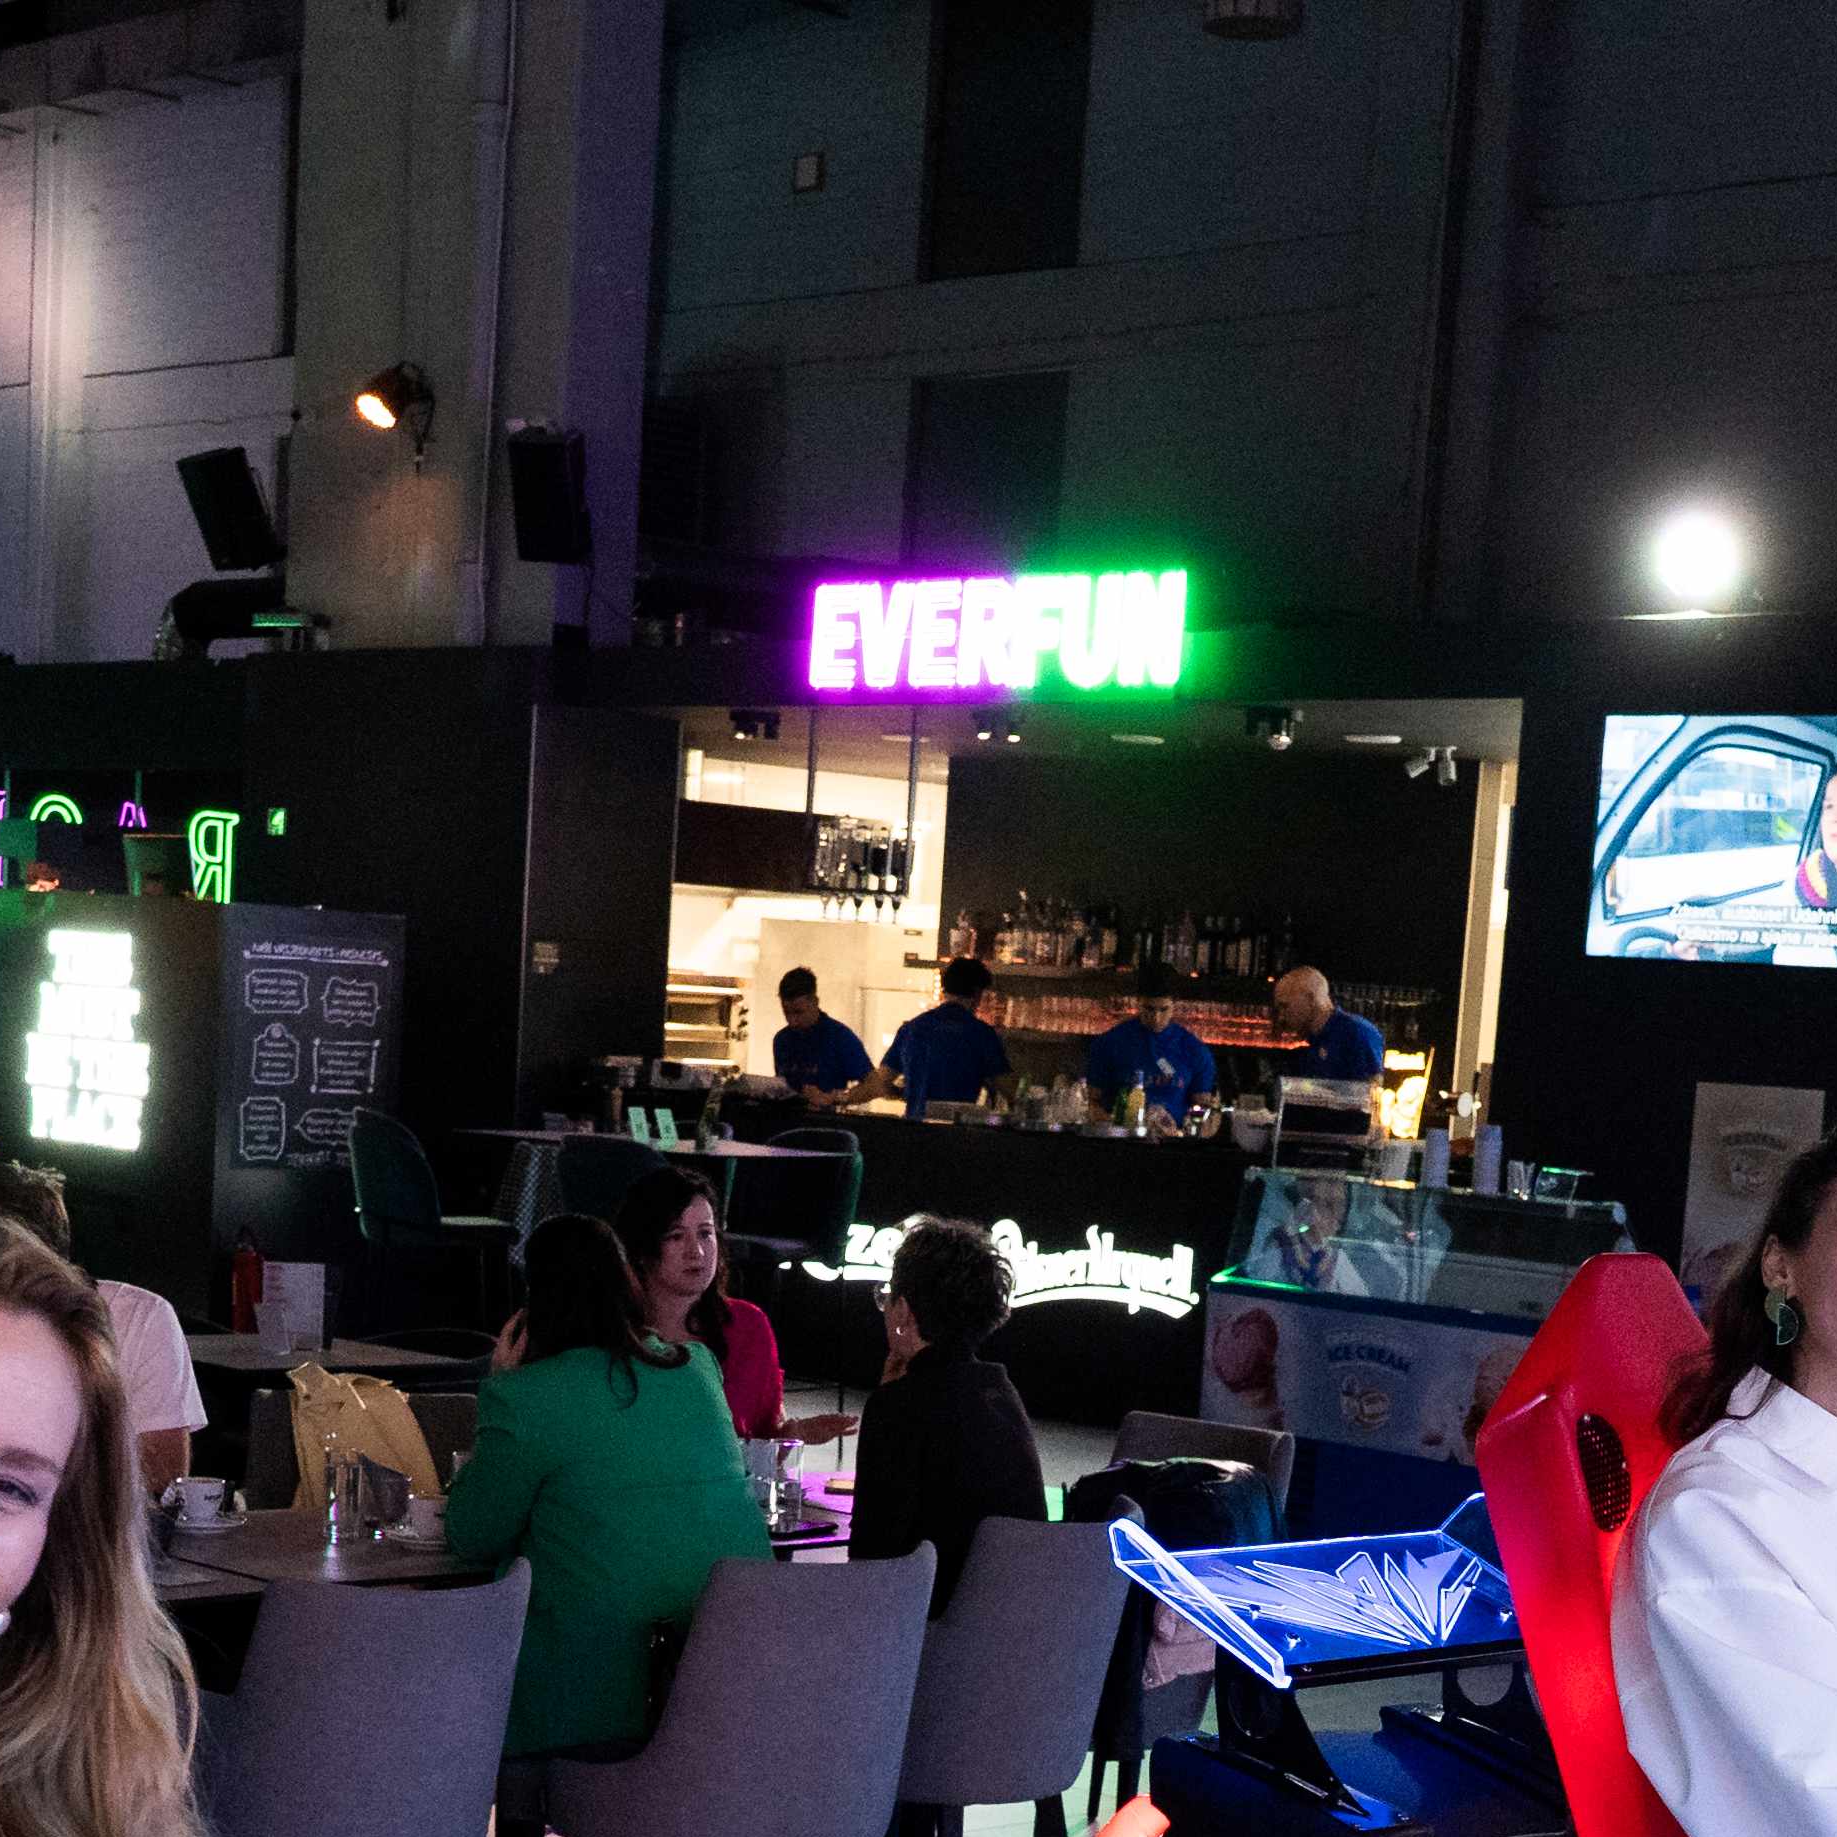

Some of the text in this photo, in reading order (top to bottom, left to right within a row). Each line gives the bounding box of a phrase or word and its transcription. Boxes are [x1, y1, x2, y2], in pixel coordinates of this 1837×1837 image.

[809, 572, 1189, 691] EVERFUN
[1741, 930, 1759, 943] na
[1328, 1345, 1412, 1373] ICE CREAM
